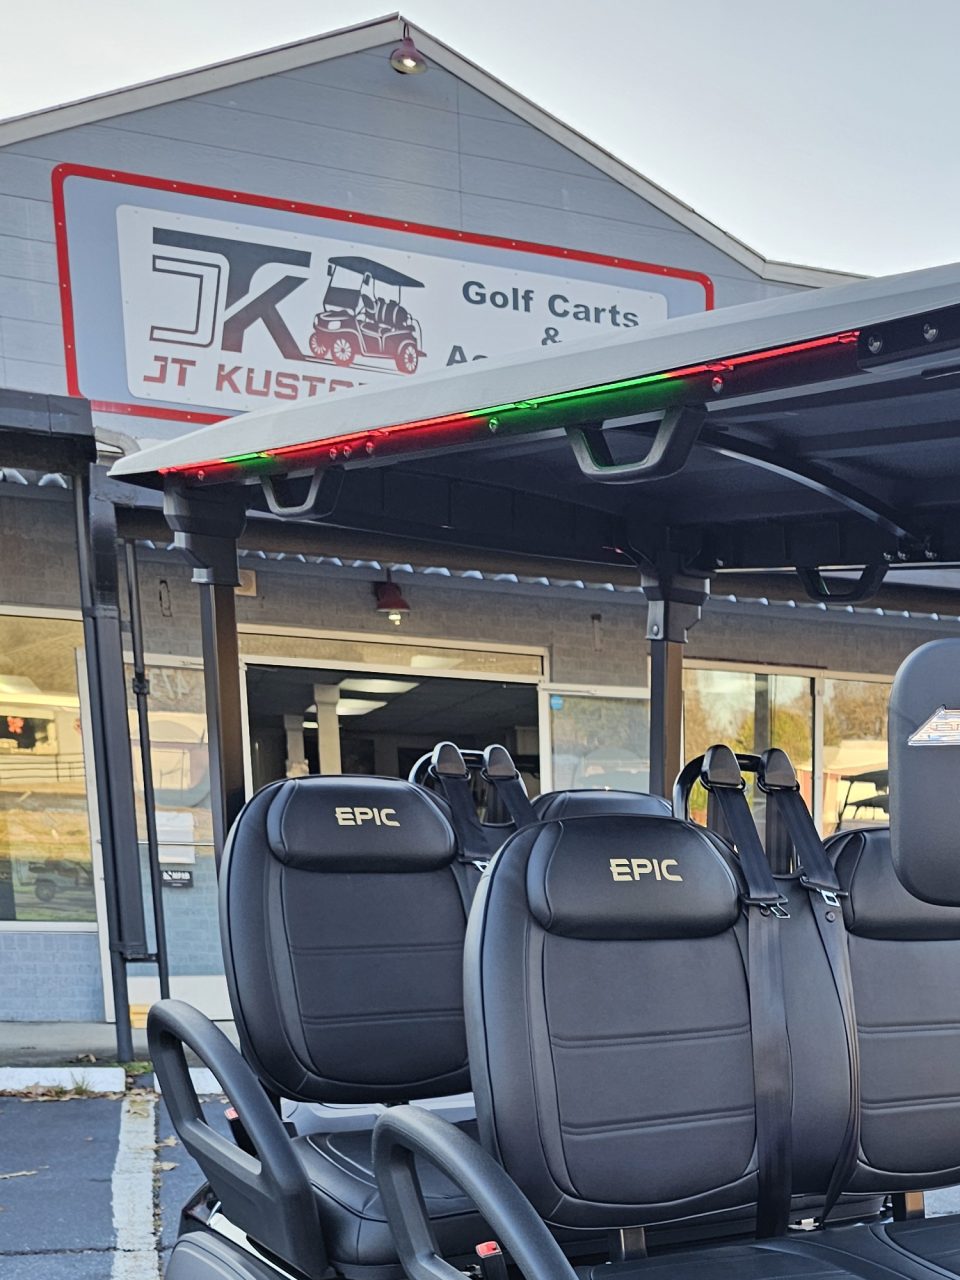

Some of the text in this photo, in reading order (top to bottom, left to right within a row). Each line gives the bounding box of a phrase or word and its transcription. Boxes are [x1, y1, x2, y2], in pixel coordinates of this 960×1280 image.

[462, 280, 639, 328] Golf Carts
[143, 355, 356, 401] JT KUST
[335, 807, 401, 827] EPIC
[609, 858, 683, 882] EPIC
